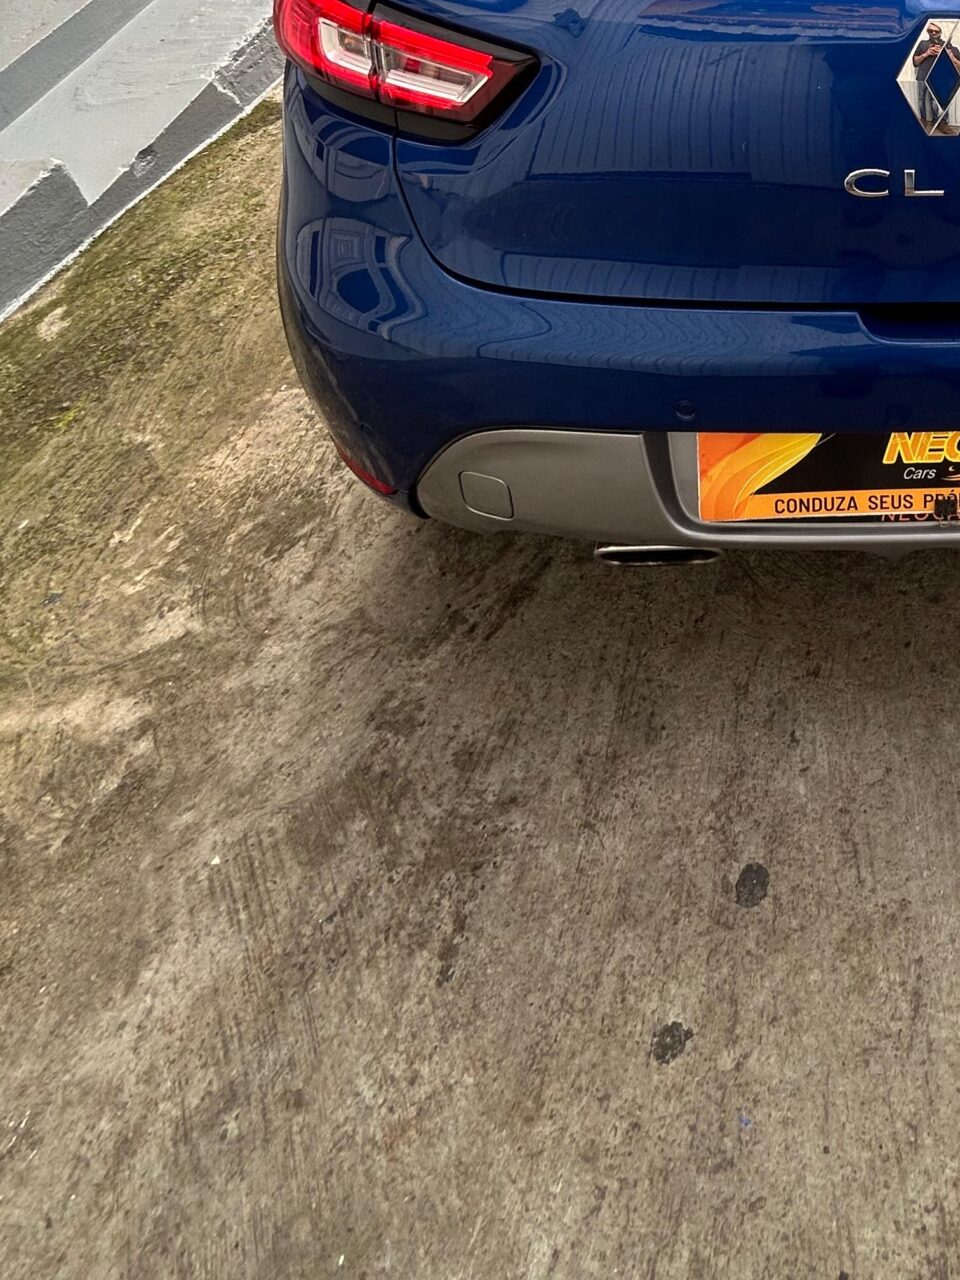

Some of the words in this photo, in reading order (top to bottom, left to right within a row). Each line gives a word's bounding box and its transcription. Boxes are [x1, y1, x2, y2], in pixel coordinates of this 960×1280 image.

[903, 466, 937, 480] Cars
[774, 496, 859, 514] CONDUZA
[868, 494, 914, 511] SEUS
